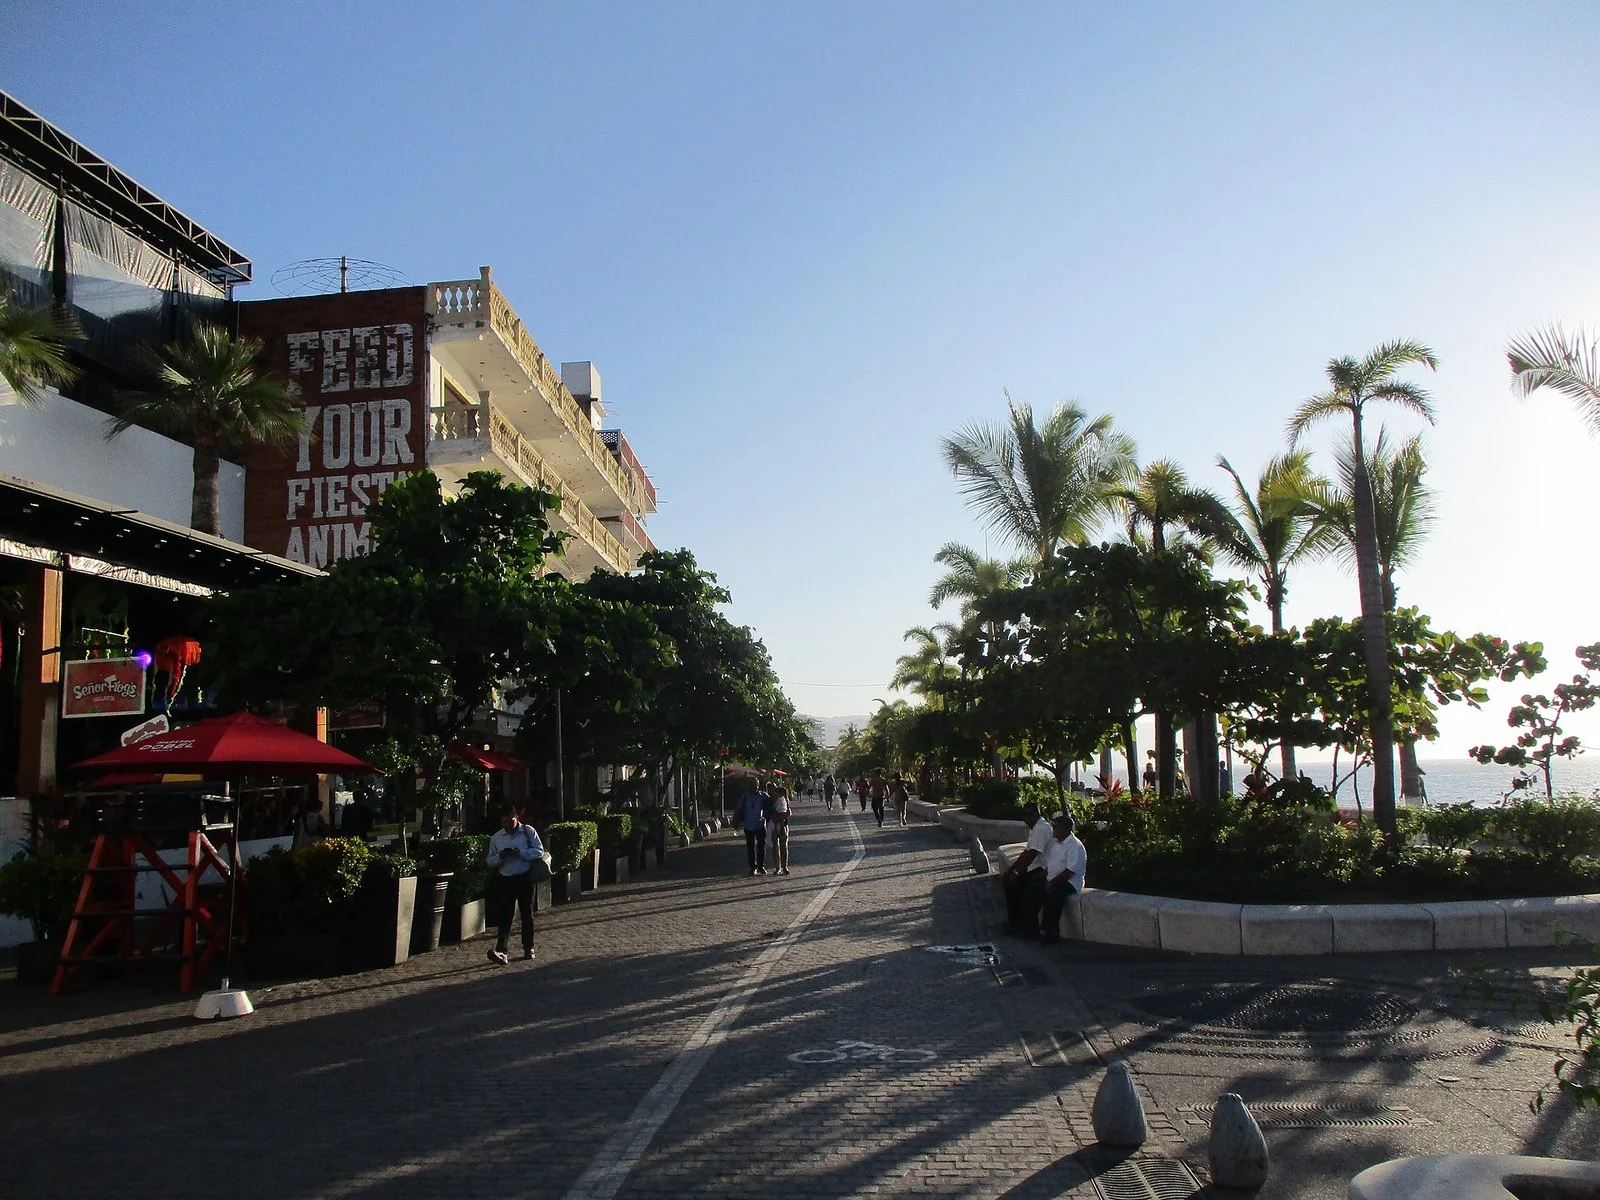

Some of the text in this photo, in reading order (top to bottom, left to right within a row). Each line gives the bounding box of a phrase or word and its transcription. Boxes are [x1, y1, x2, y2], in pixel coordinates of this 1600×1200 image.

[287, 323, 414, 395] FEED
[289, 398, 415, 472] YOUR
[73, 681, 108, 699] Señor
